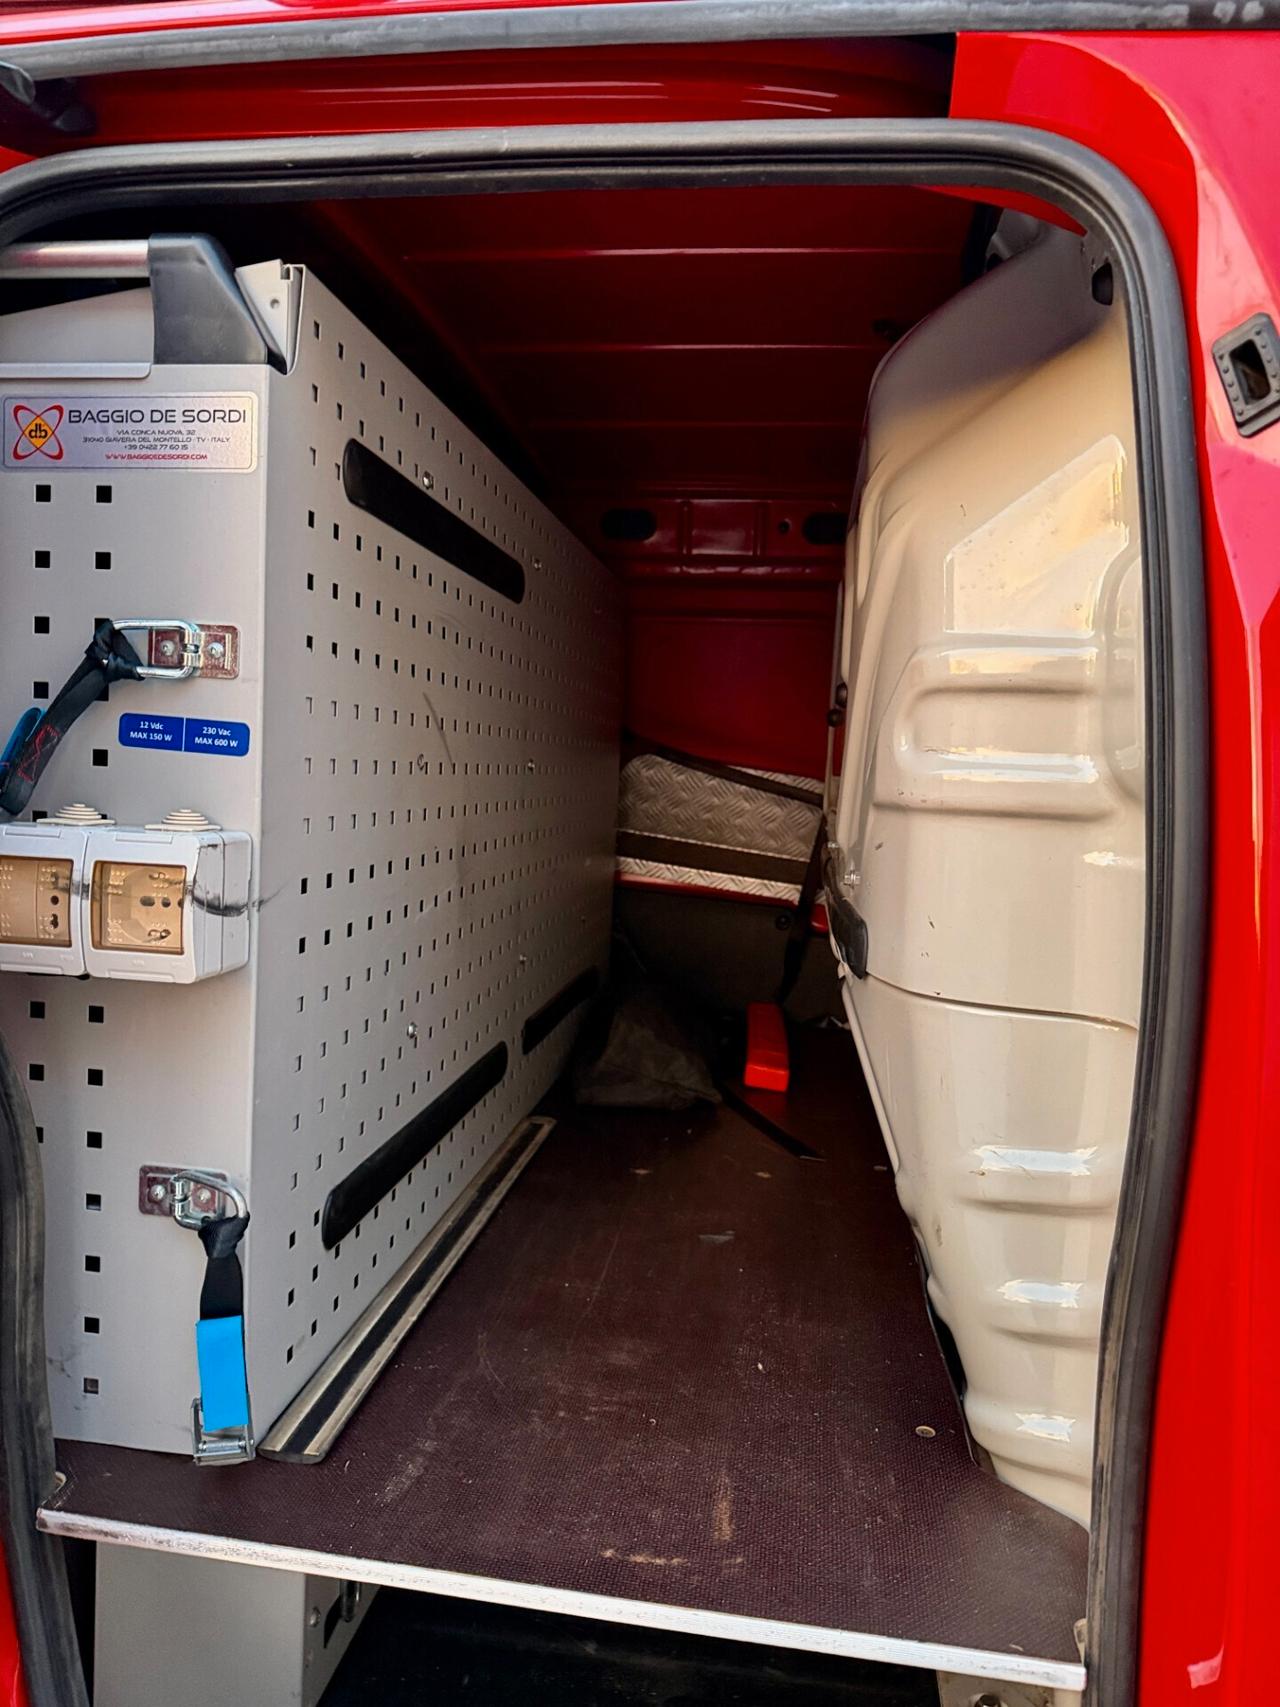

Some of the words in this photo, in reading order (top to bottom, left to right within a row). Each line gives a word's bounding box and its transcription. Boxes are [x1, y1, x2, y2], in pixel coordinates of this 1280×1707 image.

[68, 409, 145, 423] BAGGIO
[150, 409, 176, 423] DE
[182, 409, 246, 423] SORDI
[28, 423, 48, 439] db
[140, 721, 149, 729] 12
[150, 722, 164, 730] Vdc
[129, 731, 148, 739] MAX
[149, 733, 163, 741] 150
[202, 727, 216, 735] 230
[217, 728, 231, 736] Vac
[194, 737, 213, 745] MAX
[214, 738, 228, 747] 600
